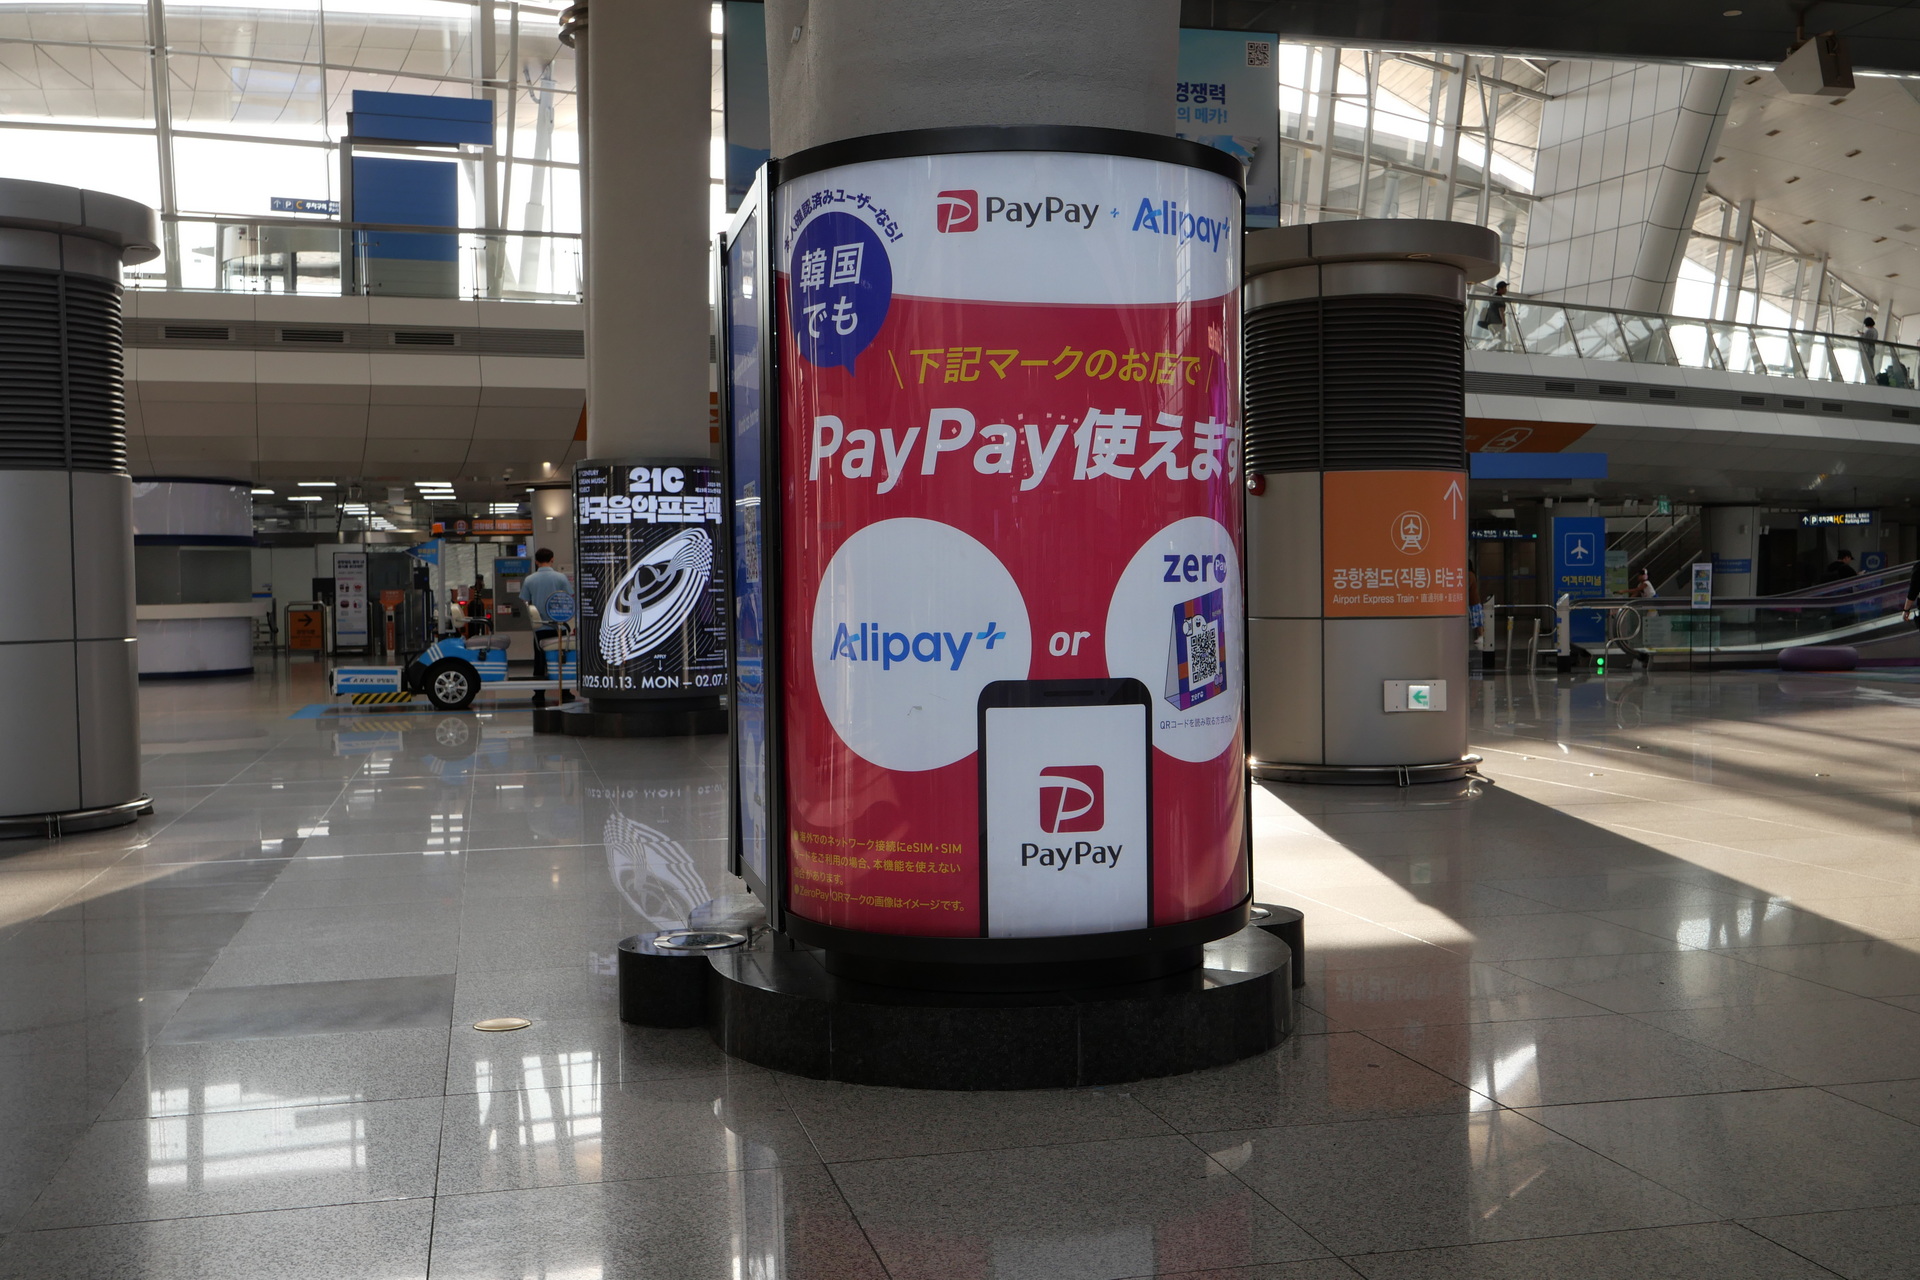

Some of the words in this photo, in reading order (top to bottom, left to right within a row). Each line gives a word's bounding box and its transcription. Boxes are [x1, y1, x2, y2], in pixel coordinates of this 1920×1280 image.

[1176, 81, 1226, 105] 경쟁력
[1194, 107, 1228, 125] 메카!
[986, 196, 1100, 230] PayPay
[799, 242, 865, 293] 韓国
[802, 296, 859, 339] でも
[910, 345, 1201, 386] 下記マークのお店で
[629, 466, 685, 493] 21C
[1332, 567, 1431, 590] 공항철도(직통)
[1435, 567, 1455, 588] 타는
[1456, 568, 1464, 588] 곳
[1561, 575, 1602, 586] 여객터미널
[1332, 593, 1361, 606] Airport
[1362, 593, 1396, 606] Express
[1396, 593, 1415, 604] Train
[829, 621, 1007, 671] Alipay+
[1048, 630, 1091, 657] or
[641, 675, 680, 690] MON
[1021, 841, 1123, 871] PayPay
